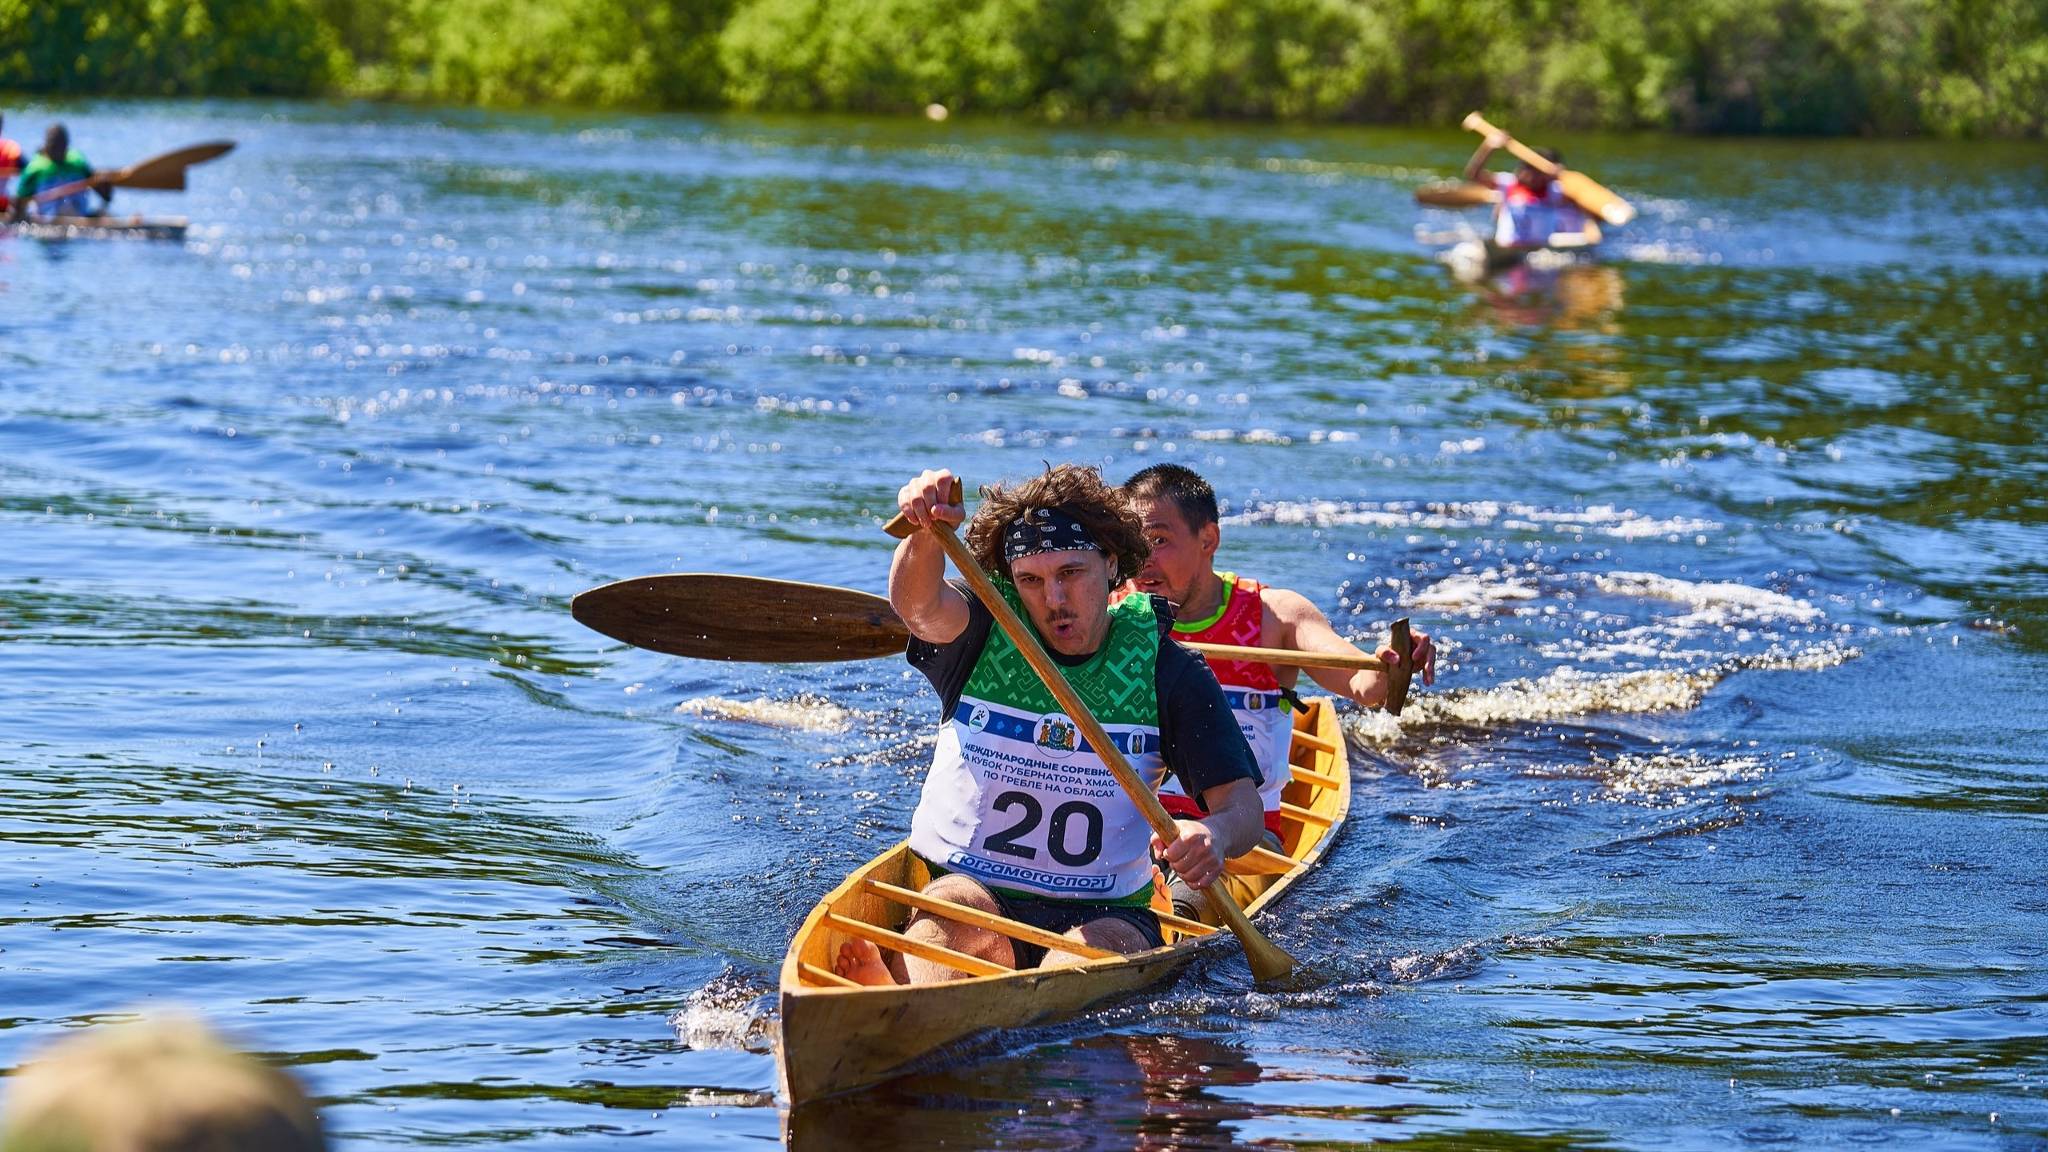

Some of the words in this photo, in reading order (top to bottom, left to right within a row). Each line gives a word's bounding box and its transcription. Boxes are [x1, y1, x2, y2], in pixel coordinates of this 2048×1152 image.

[963, 742, 1059, 771] МЕЖДУНАРОДНЫЕ
[1061, 764, 1139, 778] СОРЕВНО
[971, 755, 1003, 771] КУБОК
[1004, 764, 1083, 785] ГУБЕРНАТОРА
[1085, 778, 1121, 788] ХМАО-
[983, 769, 999, 781] ПО
[1001, 774, 1043, 790] ГРЕБЛЕ
[1045, 783, 1062, 793] НА
[1064, 786, 1115, 798] ОБЛАСАХ
[982, 790, 1104, 867] 20
